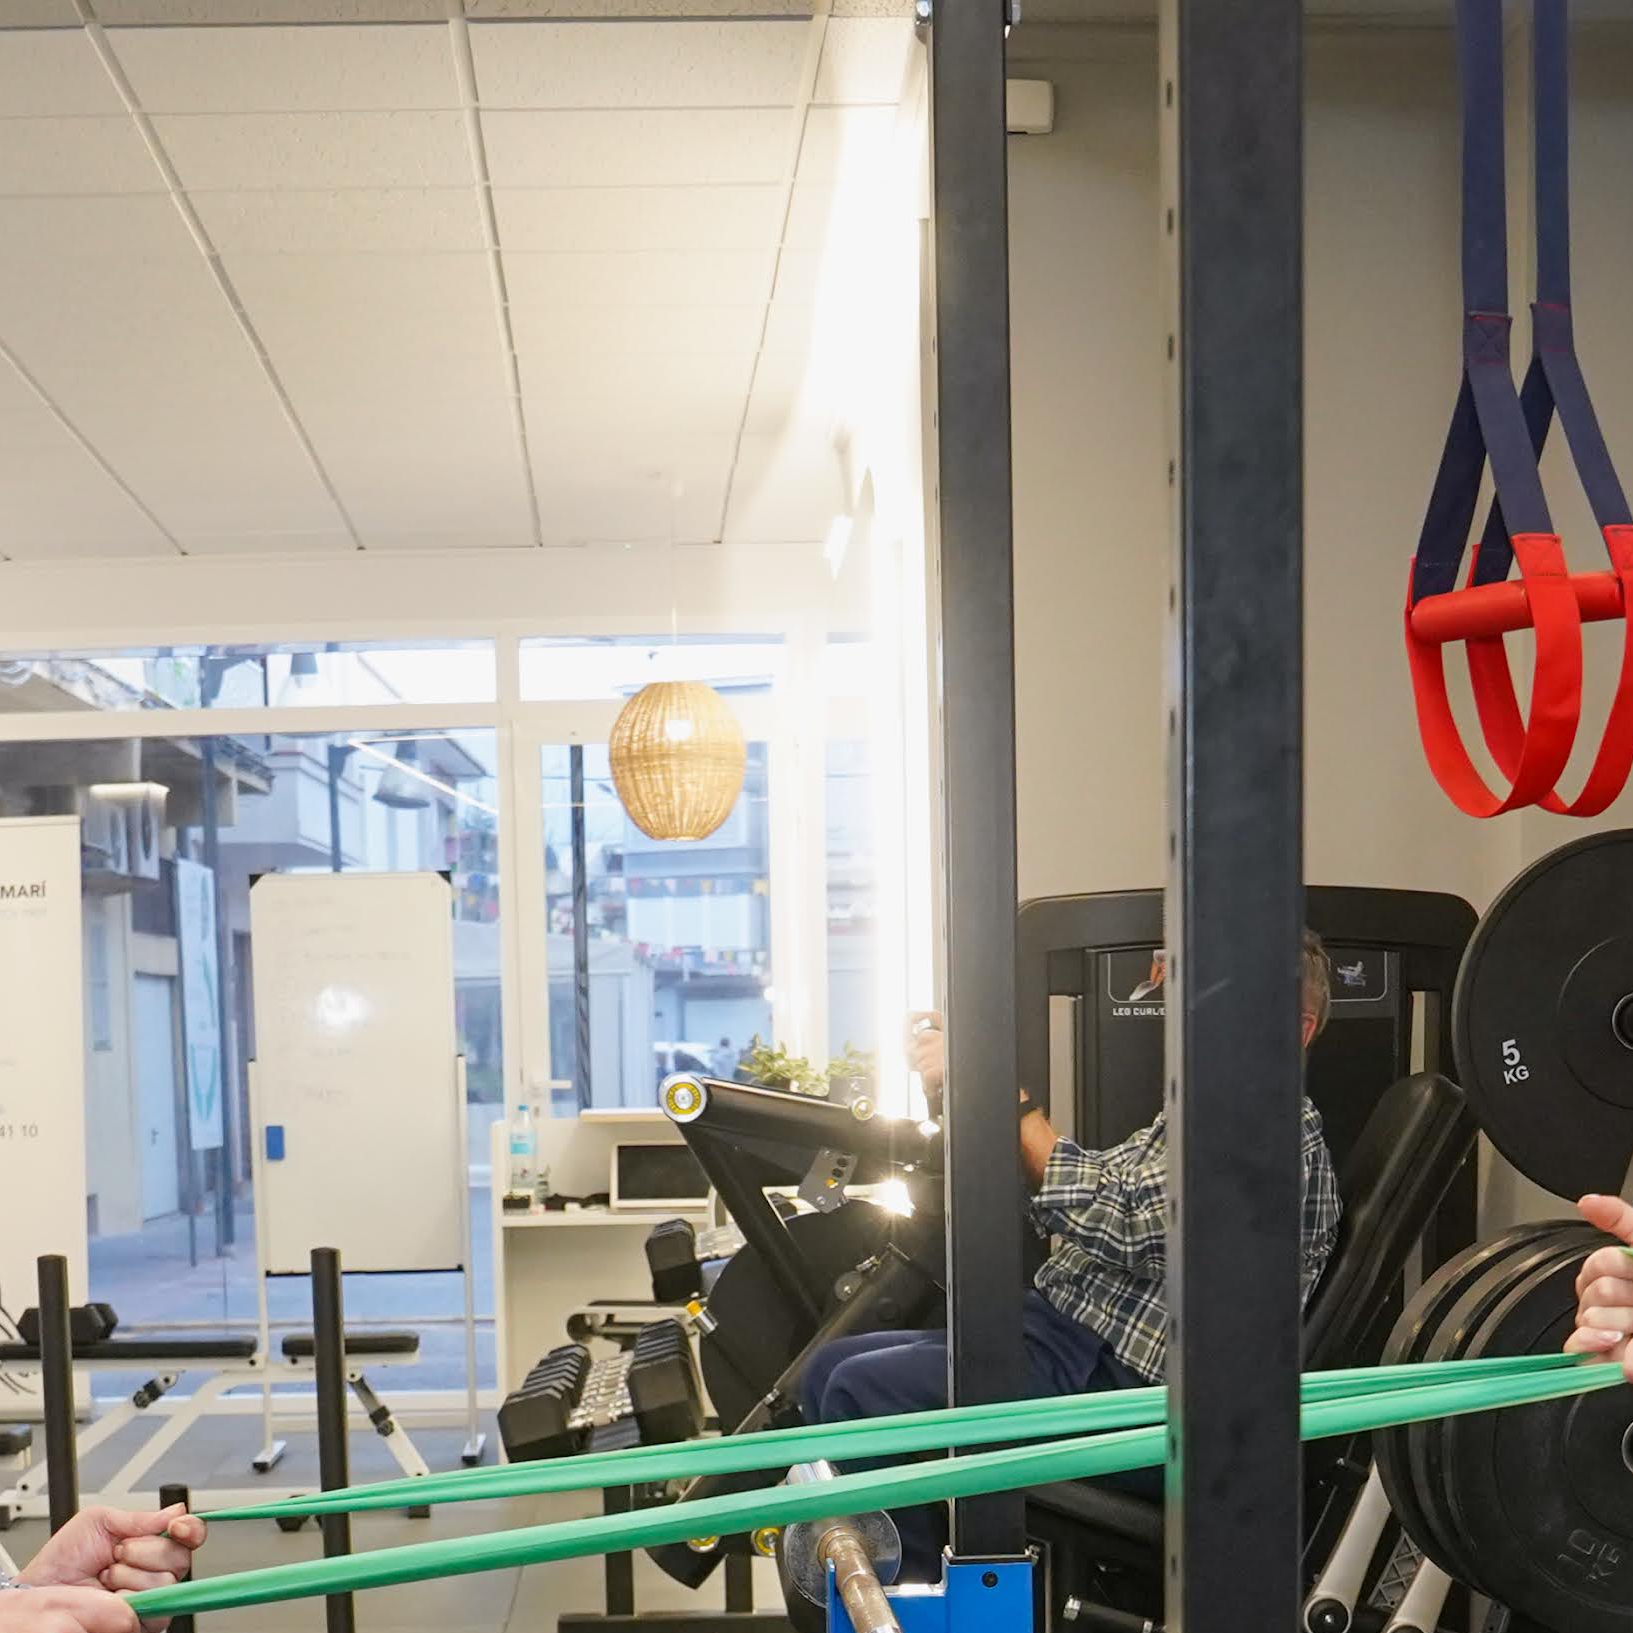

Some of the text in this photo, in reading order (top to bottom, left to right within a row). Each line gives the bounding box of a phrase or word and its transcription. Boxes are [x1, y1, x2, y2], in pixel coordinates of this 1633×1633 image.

[0, 880, 47, 900] MARÍ
[1501, 1037, 1521, 1066] 5
[1502, 1063, 1530, 1086] KG
[22, 1124, 39, 1138] 10
